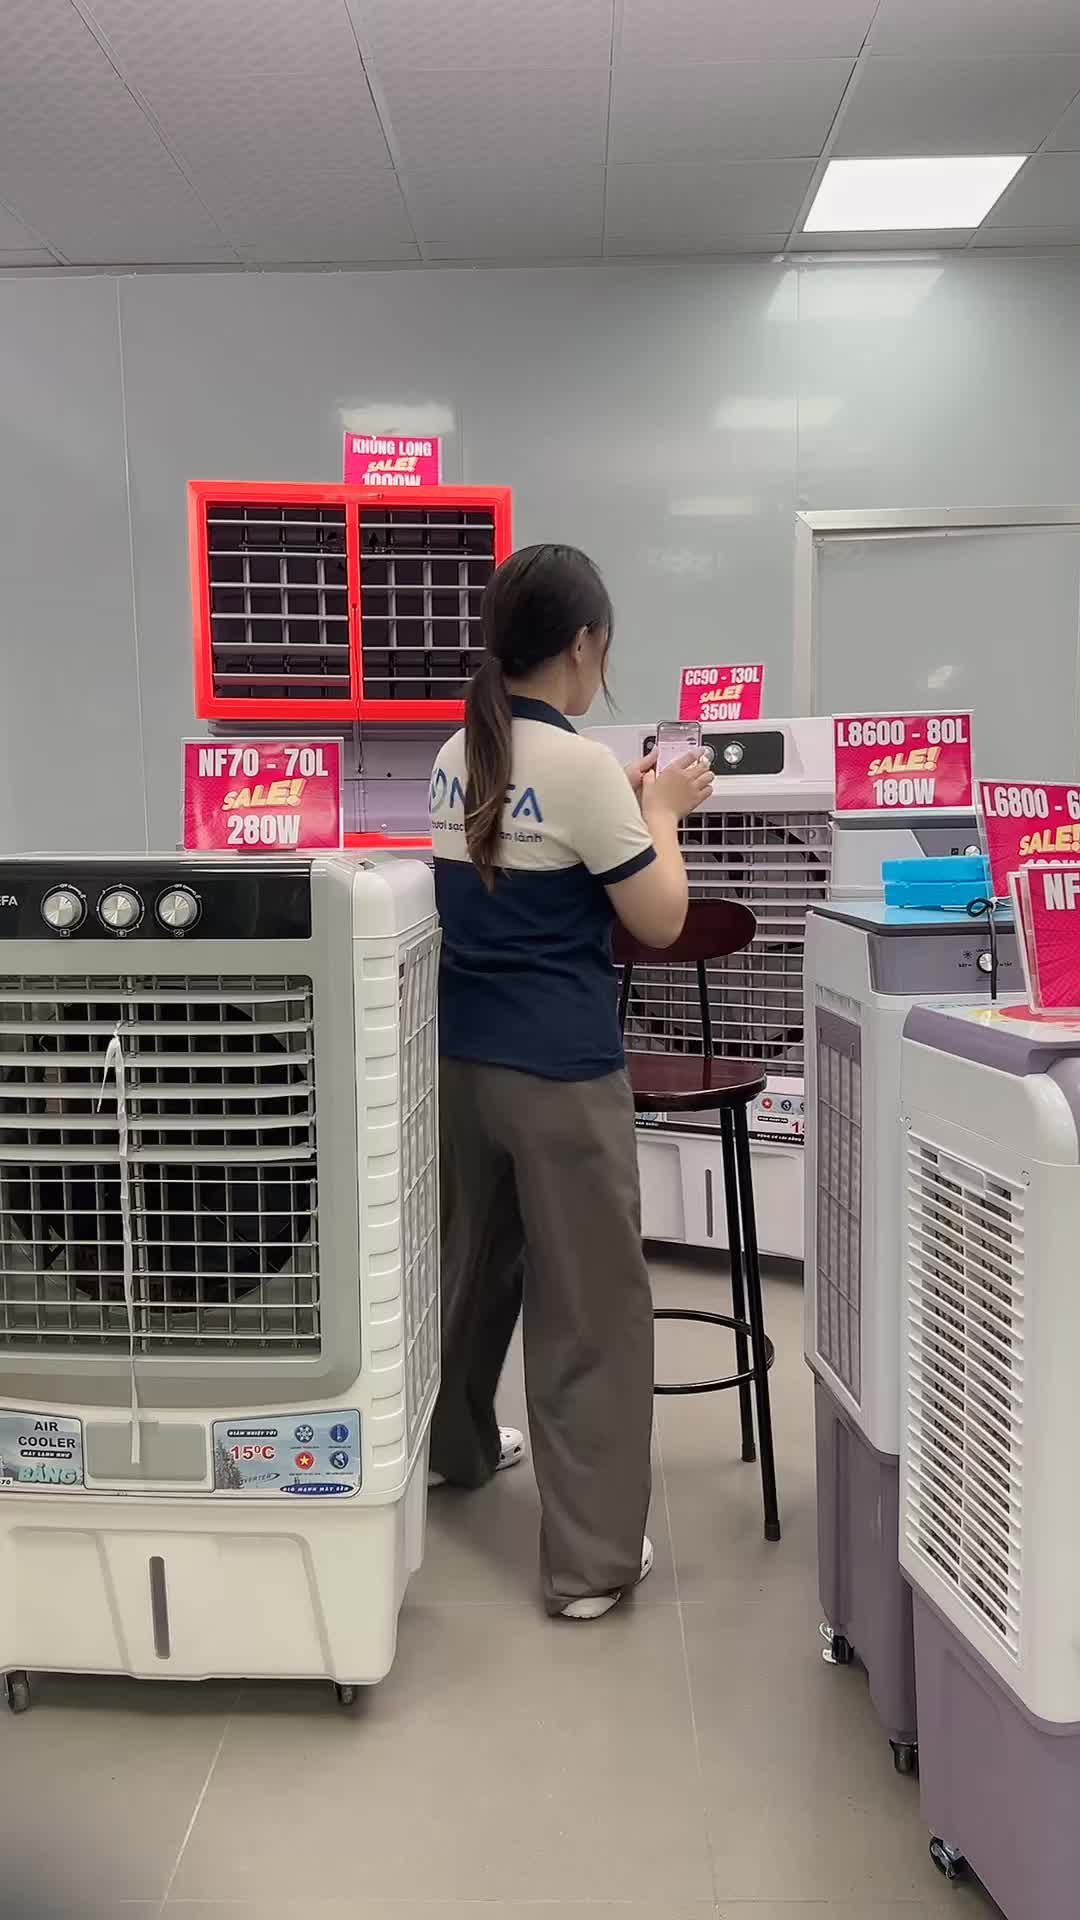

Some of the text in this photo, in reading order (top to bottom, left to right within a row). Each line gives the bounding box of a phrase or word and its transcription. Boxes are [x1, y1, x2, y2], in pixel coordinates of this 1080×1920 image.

[399, 441, 433, 457] LONG
[367, 457, 418, 473] SALE!
[361, 473, 421, 486] 1000W
[730, 667, 760, 684] 130L
[699, 684, 744, 703] SALE!
[700, 702, 742, 721] 350W
[837, 720, 905, 747] L8600
[927, 718, 968, 744] 80L
[198, 748, 260, 777] NF70
[284, 748, 329, 777] 70L
[867, 746, 942, 776] SALE!
[221, 778, 307, 811] SALE!
[873, 778, 936, 806] 180W
[982, 786, 1049, 819] L6800
[1067, 790, 1080, 820] 6
[227, 815, 301, 845] 280W
[0, 895, 18, 907] FA
[34, 1422, 59, 1432] AIR
[18, 1436, 76, 1448] COOLER
